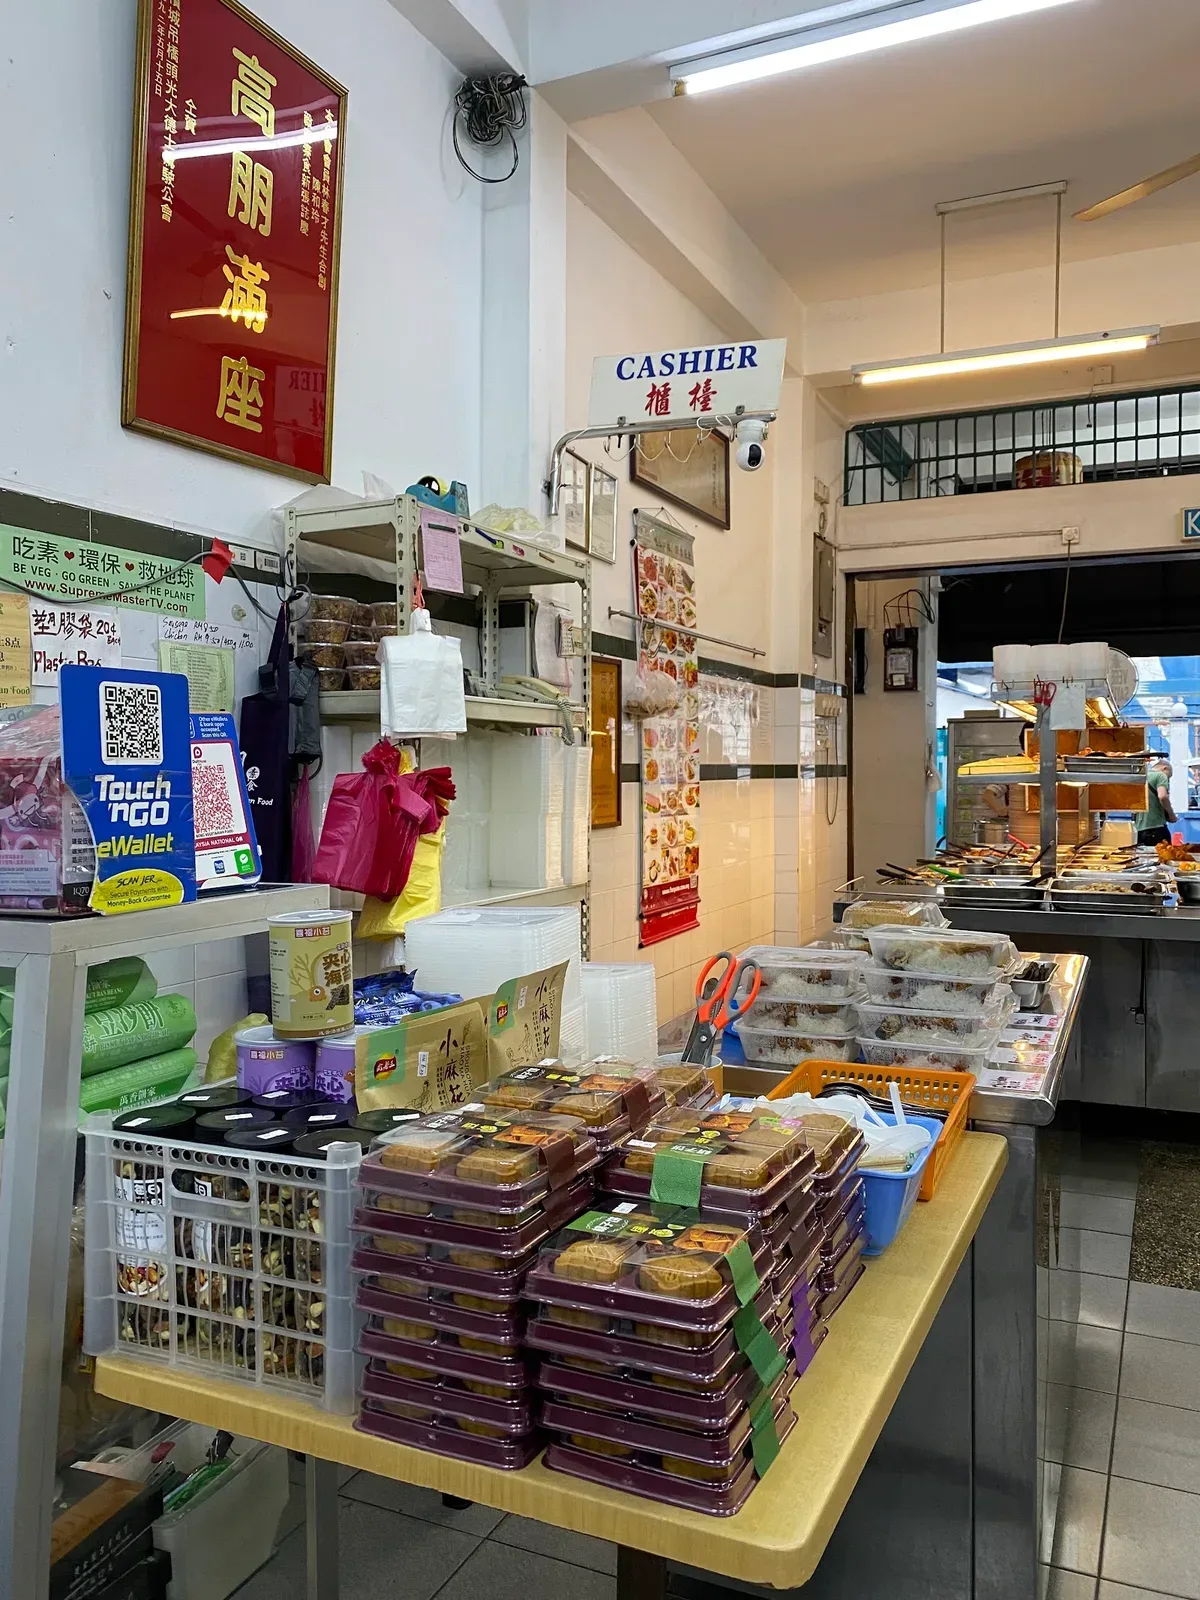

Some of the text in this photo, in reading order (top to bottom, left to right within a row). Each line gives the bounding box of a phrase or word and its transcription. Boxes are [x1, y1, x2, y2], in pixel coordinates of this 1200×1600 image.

[215, 46, 277, 433] 高朋滿座
[616, 345, 758, 381] CASHIER
[1187, 511, 1200, 535] K
[12, 536, 195, 588] 吃素 環保 救地球
[13, 563, 27, 574] BE
[31, 565, 51, 578] VEG
[61, 571, 76, 582] GO
[79, 574, 110, 588] GREEN
[145, 586, 162, 597] THE
[164, 591, 196, 602] PLANET
[94, 774, 171, 801] Touch
[257, 797, 274, 806] Food
[97, 832, 174, 858] eWallet
[109, 890, 128, 898] Secure
[130, 888, 156, 897] Payments
[115, 875, 138, 889] SCAN
[107, 894, 171, 908] Money-Back Guarantee
[440, 1028, 466, 1104] 小麻花
